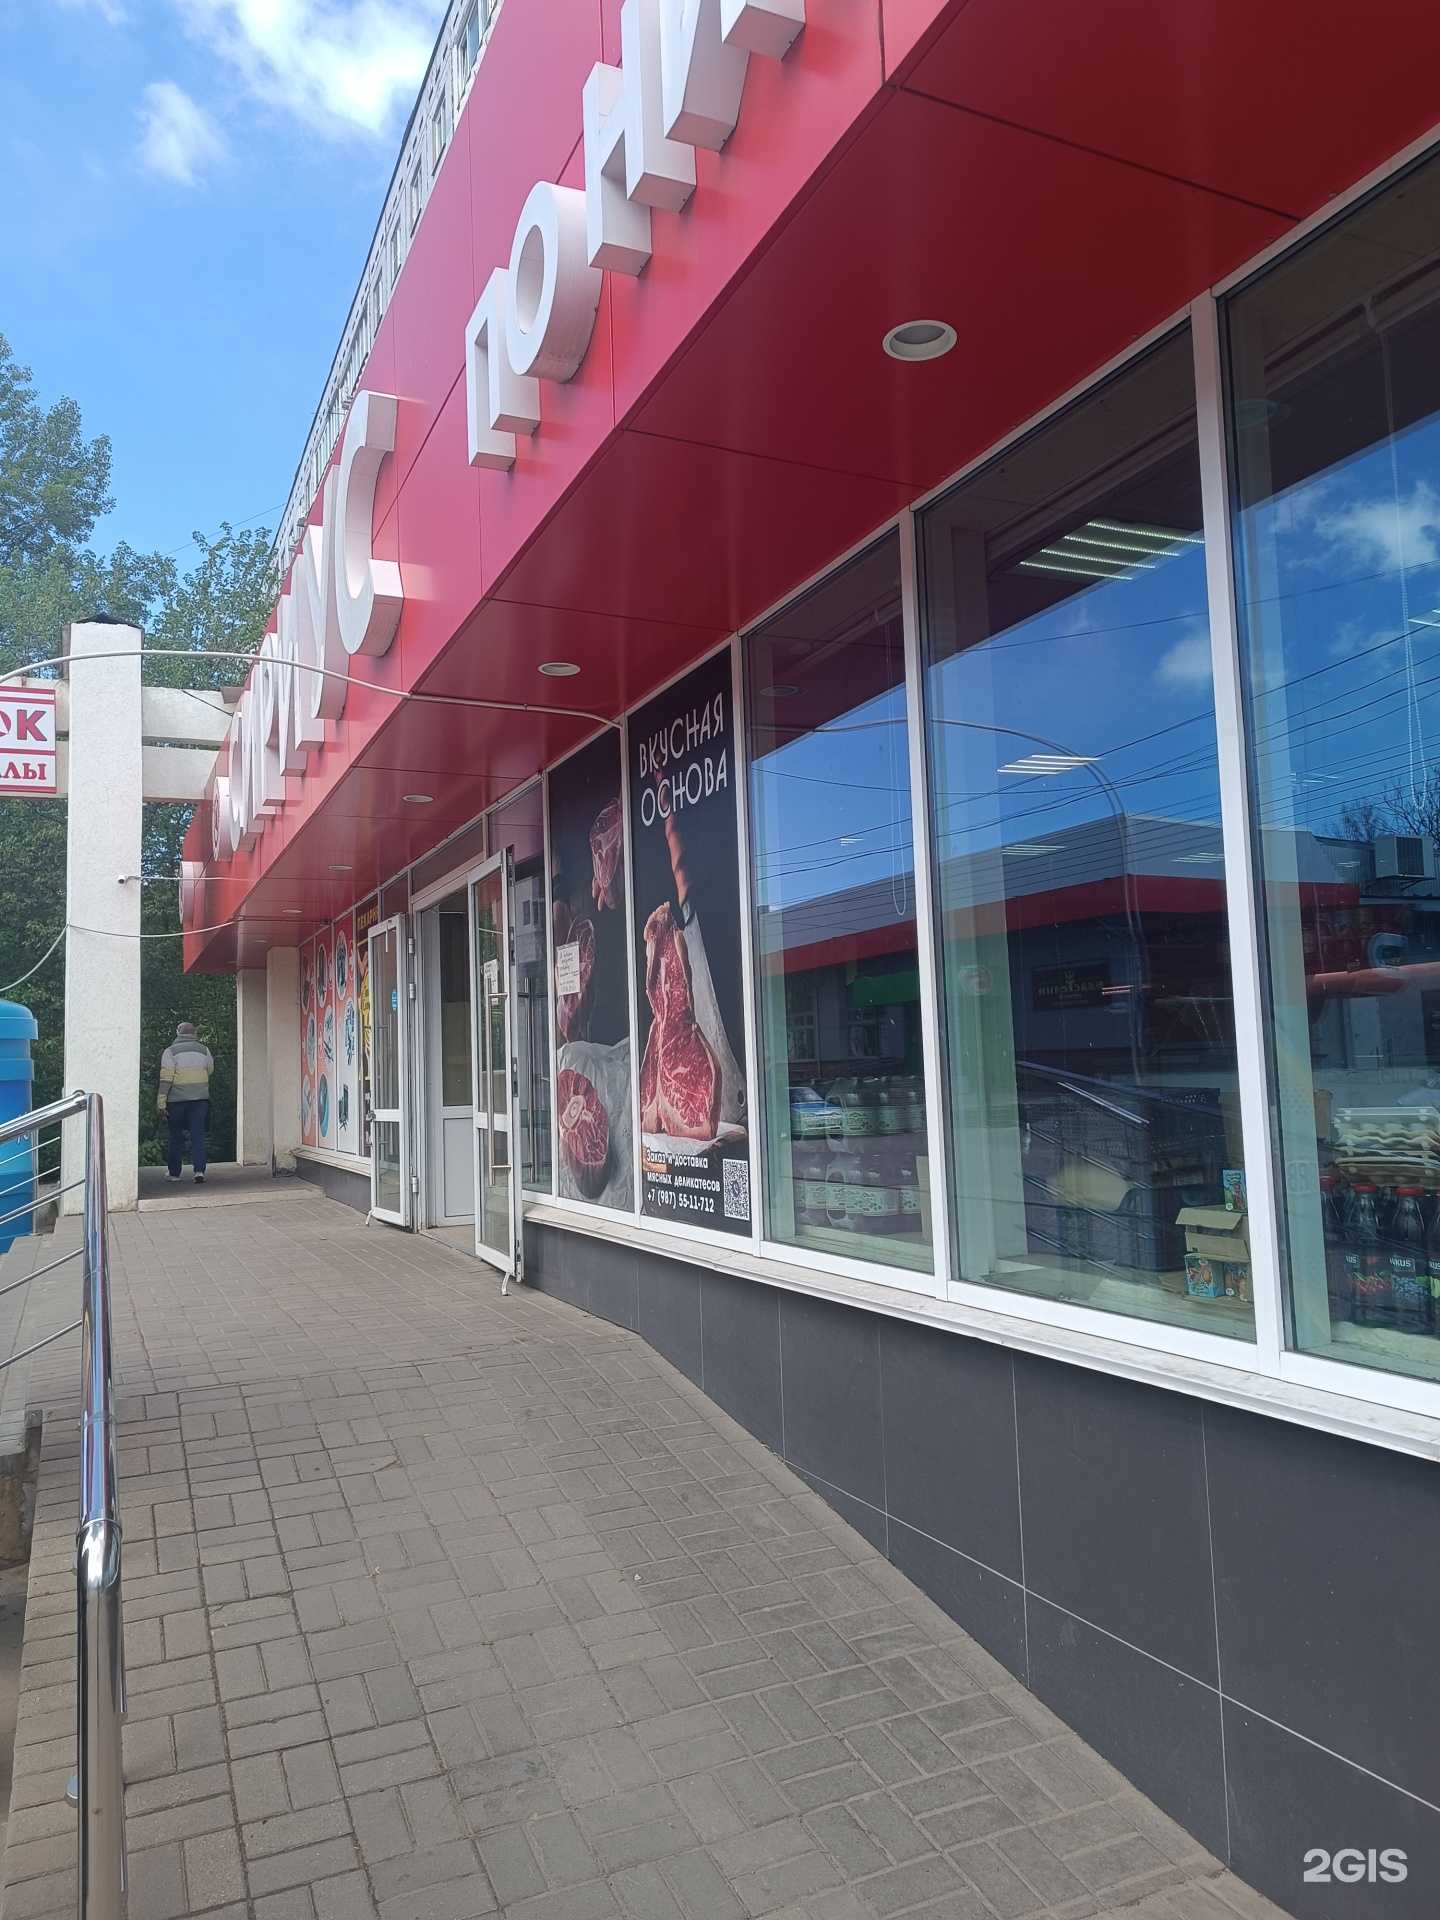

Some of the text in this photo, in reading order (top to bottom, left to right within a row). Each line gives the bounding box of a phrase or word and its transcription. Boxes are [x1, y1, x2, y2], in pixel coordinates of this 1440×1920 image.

[640, 692, 724, 779] ВКУСНАЯ
[0, 761, 47, 780] ЛЫ
[641, 748, 728, 826] ОСНОВА
[646, 1147, 666, 1164] Заказ
[675, 1154, 709, 1169] доставка
[647, 1171, 721, 1192] мясных деликатесов
[647, 1188, 715, 1213] +7 (987) 55-11-712
